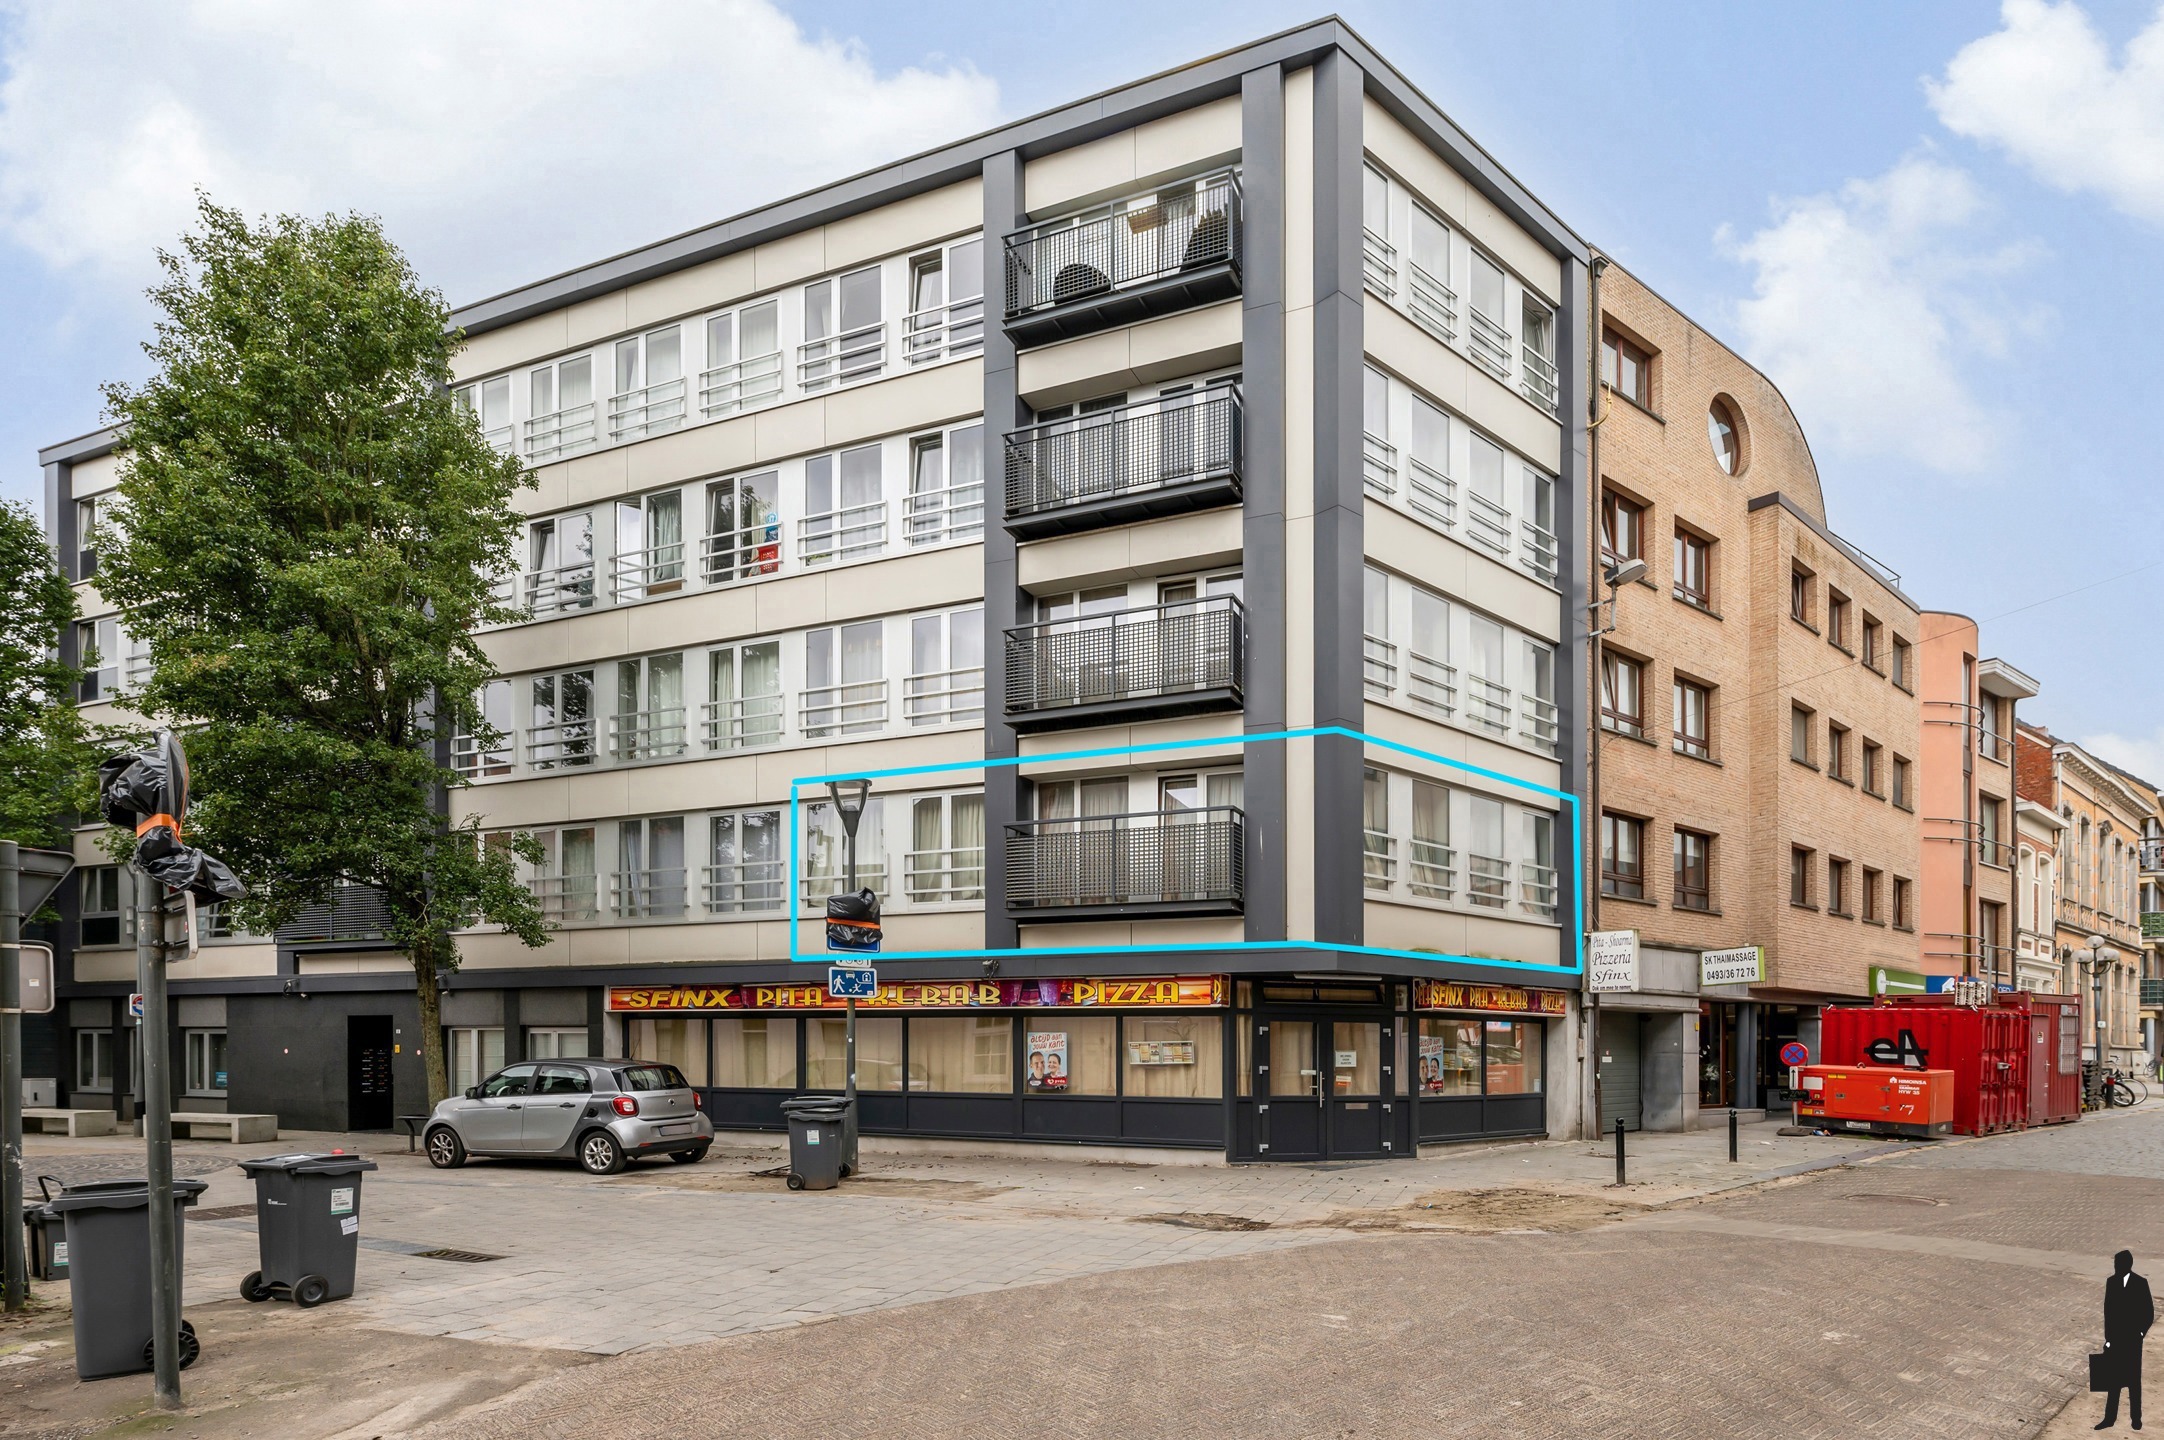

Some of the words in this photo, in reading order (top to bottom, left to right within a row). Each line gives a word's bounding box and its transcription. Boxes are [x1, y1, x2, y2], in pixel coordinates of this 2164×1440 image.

[1608, 933, 1632, 948] Shoarma
[1592, 949, 1631, 966] Pizzeria
[1705, 955, 1713, 965] SK
[1713, 951, 1756, 964] THAIMASSAGE
[1592, 968, 1632, 985] Sfinx
[1707, 969, 1735, 980] 0493/36
[1736, 968, 1745, 978] 72
[1746, 967, 1756, 977] 76
[629, 989, 734, 1008] SFINX
[756, 986, 822, 1007] PITA
[862, 984, 1001, 1006] KEBAB
[1073, 981, 1180, 1004] PIZZA
[1433, 985, 1464, 1006] SFINX
[1470, 987, 1488, 1007] PITA
[1497, 989, 1528, 1010] KEBAB
[1541, 992, 1561, 1011] PIZZA
